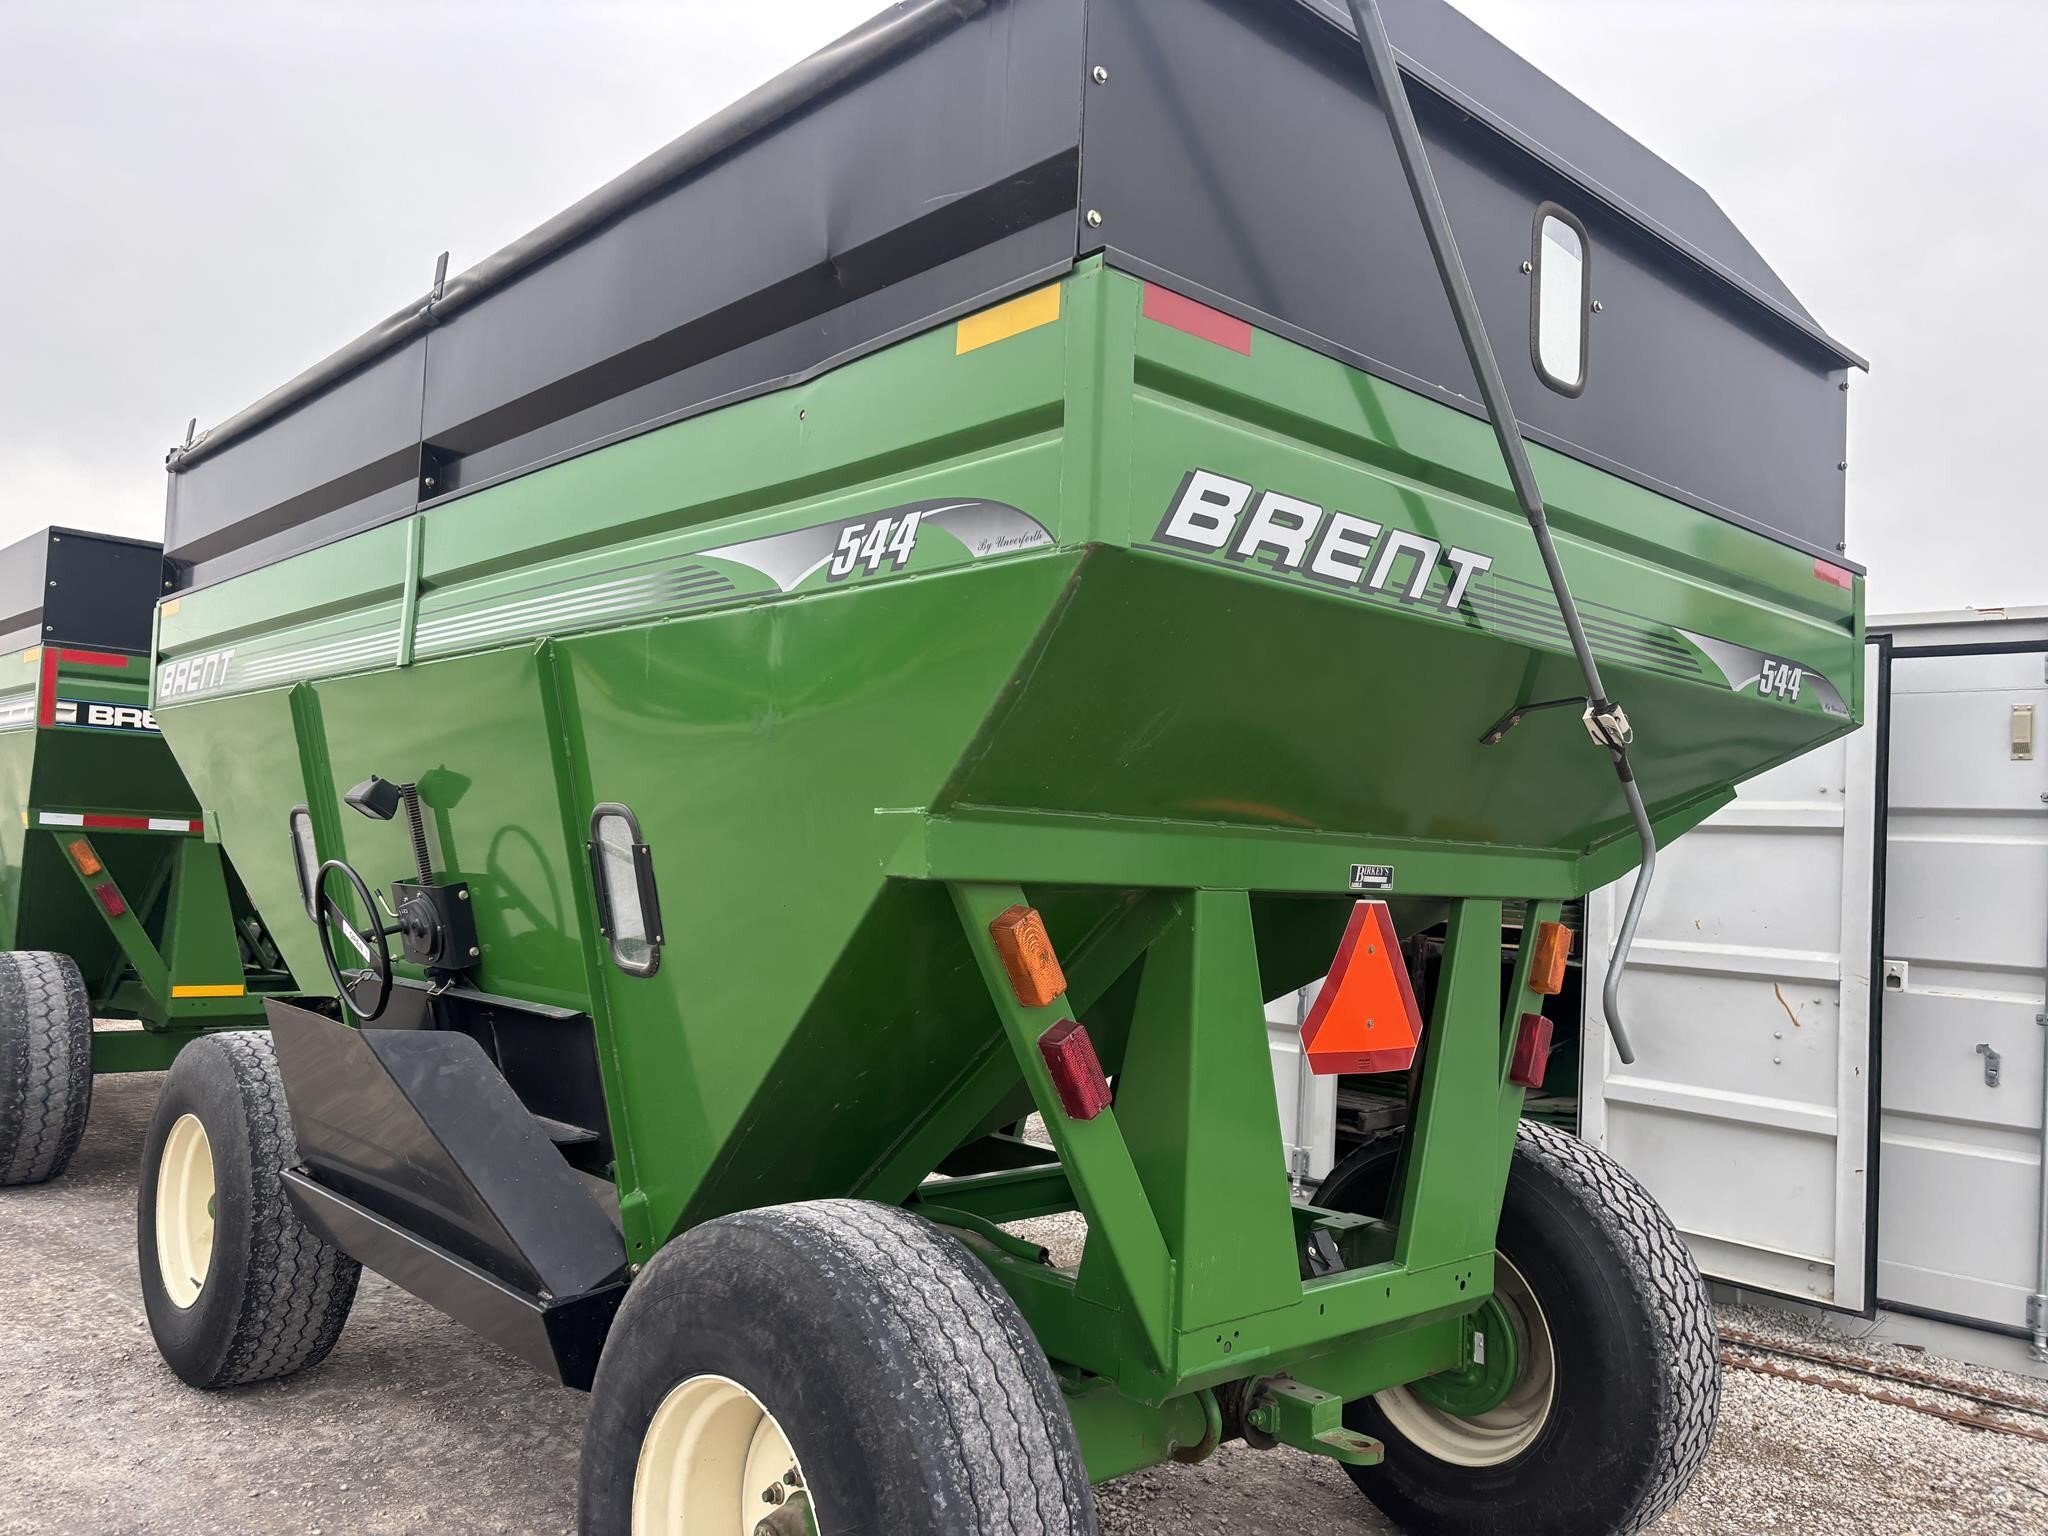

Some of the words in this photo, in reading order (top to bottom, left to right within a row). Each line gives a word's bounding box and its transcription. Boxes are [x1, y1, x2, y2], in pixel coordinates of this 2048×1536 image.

[829, 511, 922, 580] 544
[977, 538, 993, 554] By
[1154, 468, 1494, 611] BRENT
[160, 648, 236, 699] BRENT
[1758, 659, 1802, 703] 544
